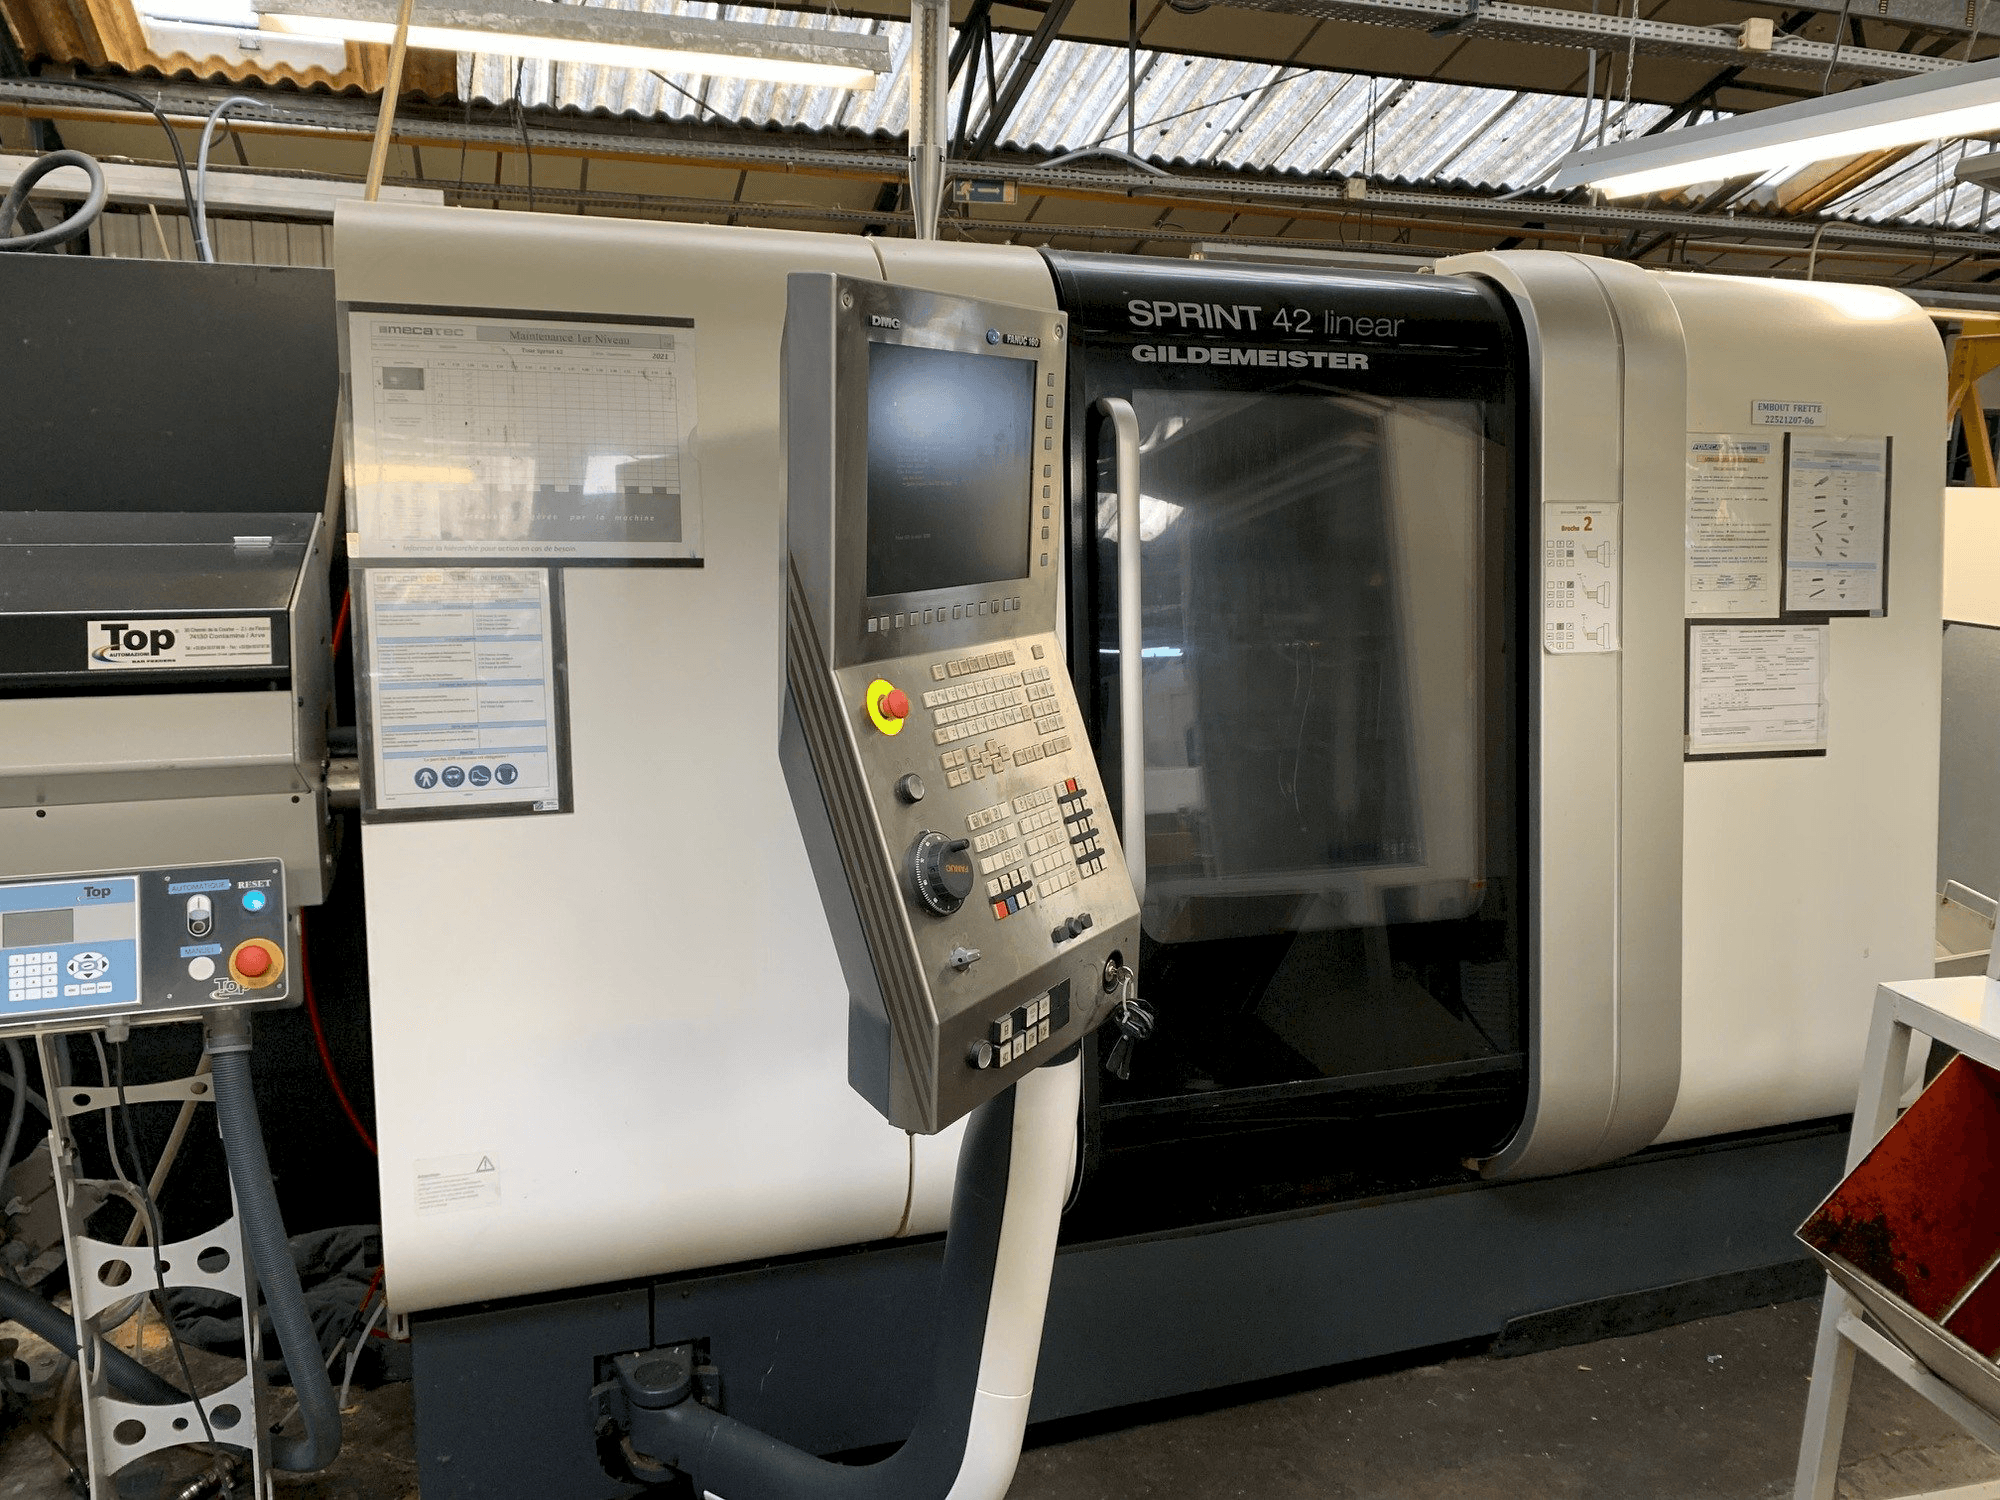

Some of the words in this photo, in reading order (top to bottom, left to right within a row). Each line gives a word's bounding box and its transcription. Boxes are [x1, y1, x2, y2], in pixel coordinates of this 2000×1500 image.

[871, 315, 901, 330] DMG
[1127, 299, 1262, 331] SPRINT
[1272, 307, 1314, 334] 42
[1324, 309, 1405, 338] linear
[509, 330, 573, 344] Maintenance
[577, 333, 593, 344] 1er
[594, 334, 631, 345] Niveau
[1131, 344, 1369, 370] GILDEMEISTER
[1757, 402, 1790, 412] EMBOUT
[1793, 404, 1823, 413] FRETTE
[1765, 415, 1814, 425] 22521207-06
[1583, 516, 1593, 532] 2
[100, 623, 176, 656] Top
[237, 879, 271, 890] RESET
[83, 886, 111, 900] Top
